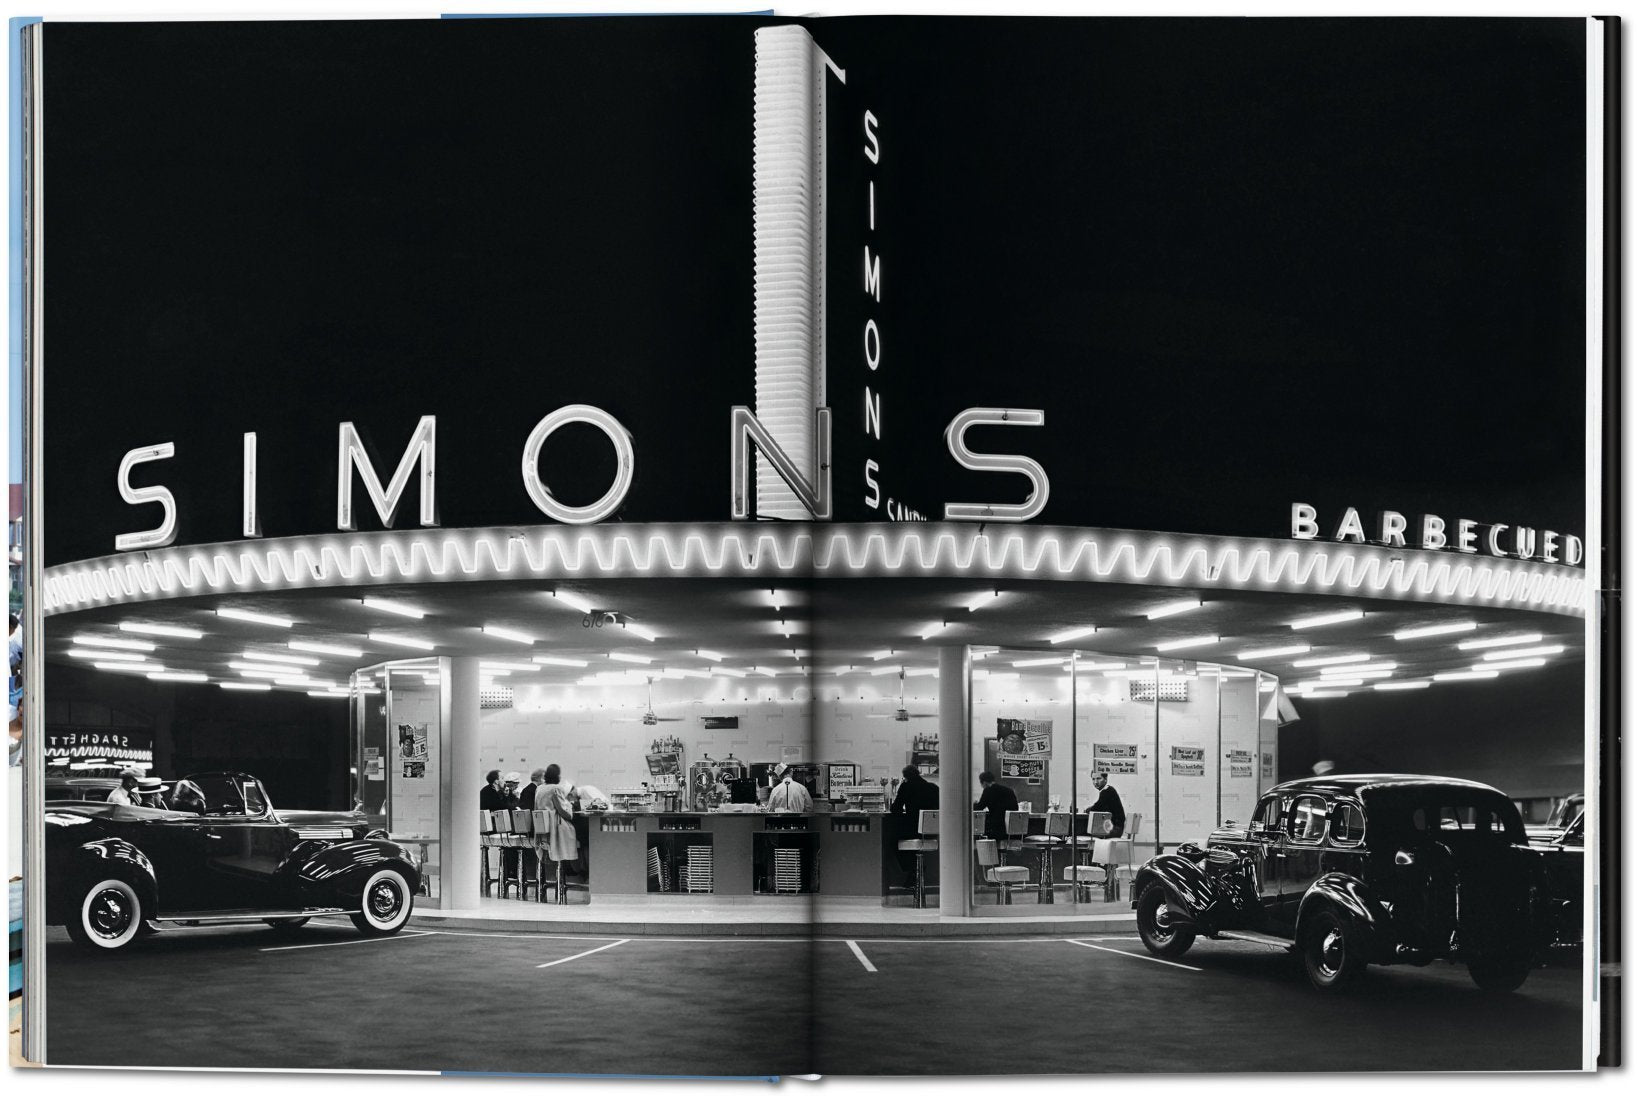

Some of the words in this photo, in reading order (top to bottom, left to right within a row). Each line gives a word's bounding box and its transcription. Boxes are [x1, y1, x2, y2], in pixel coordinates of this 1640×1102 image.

[864, 110, 880, 509] SIMONS
[115, 404, 1050, 549] SIMONS
[1292, 502, 1583, 565] BARBECUED
